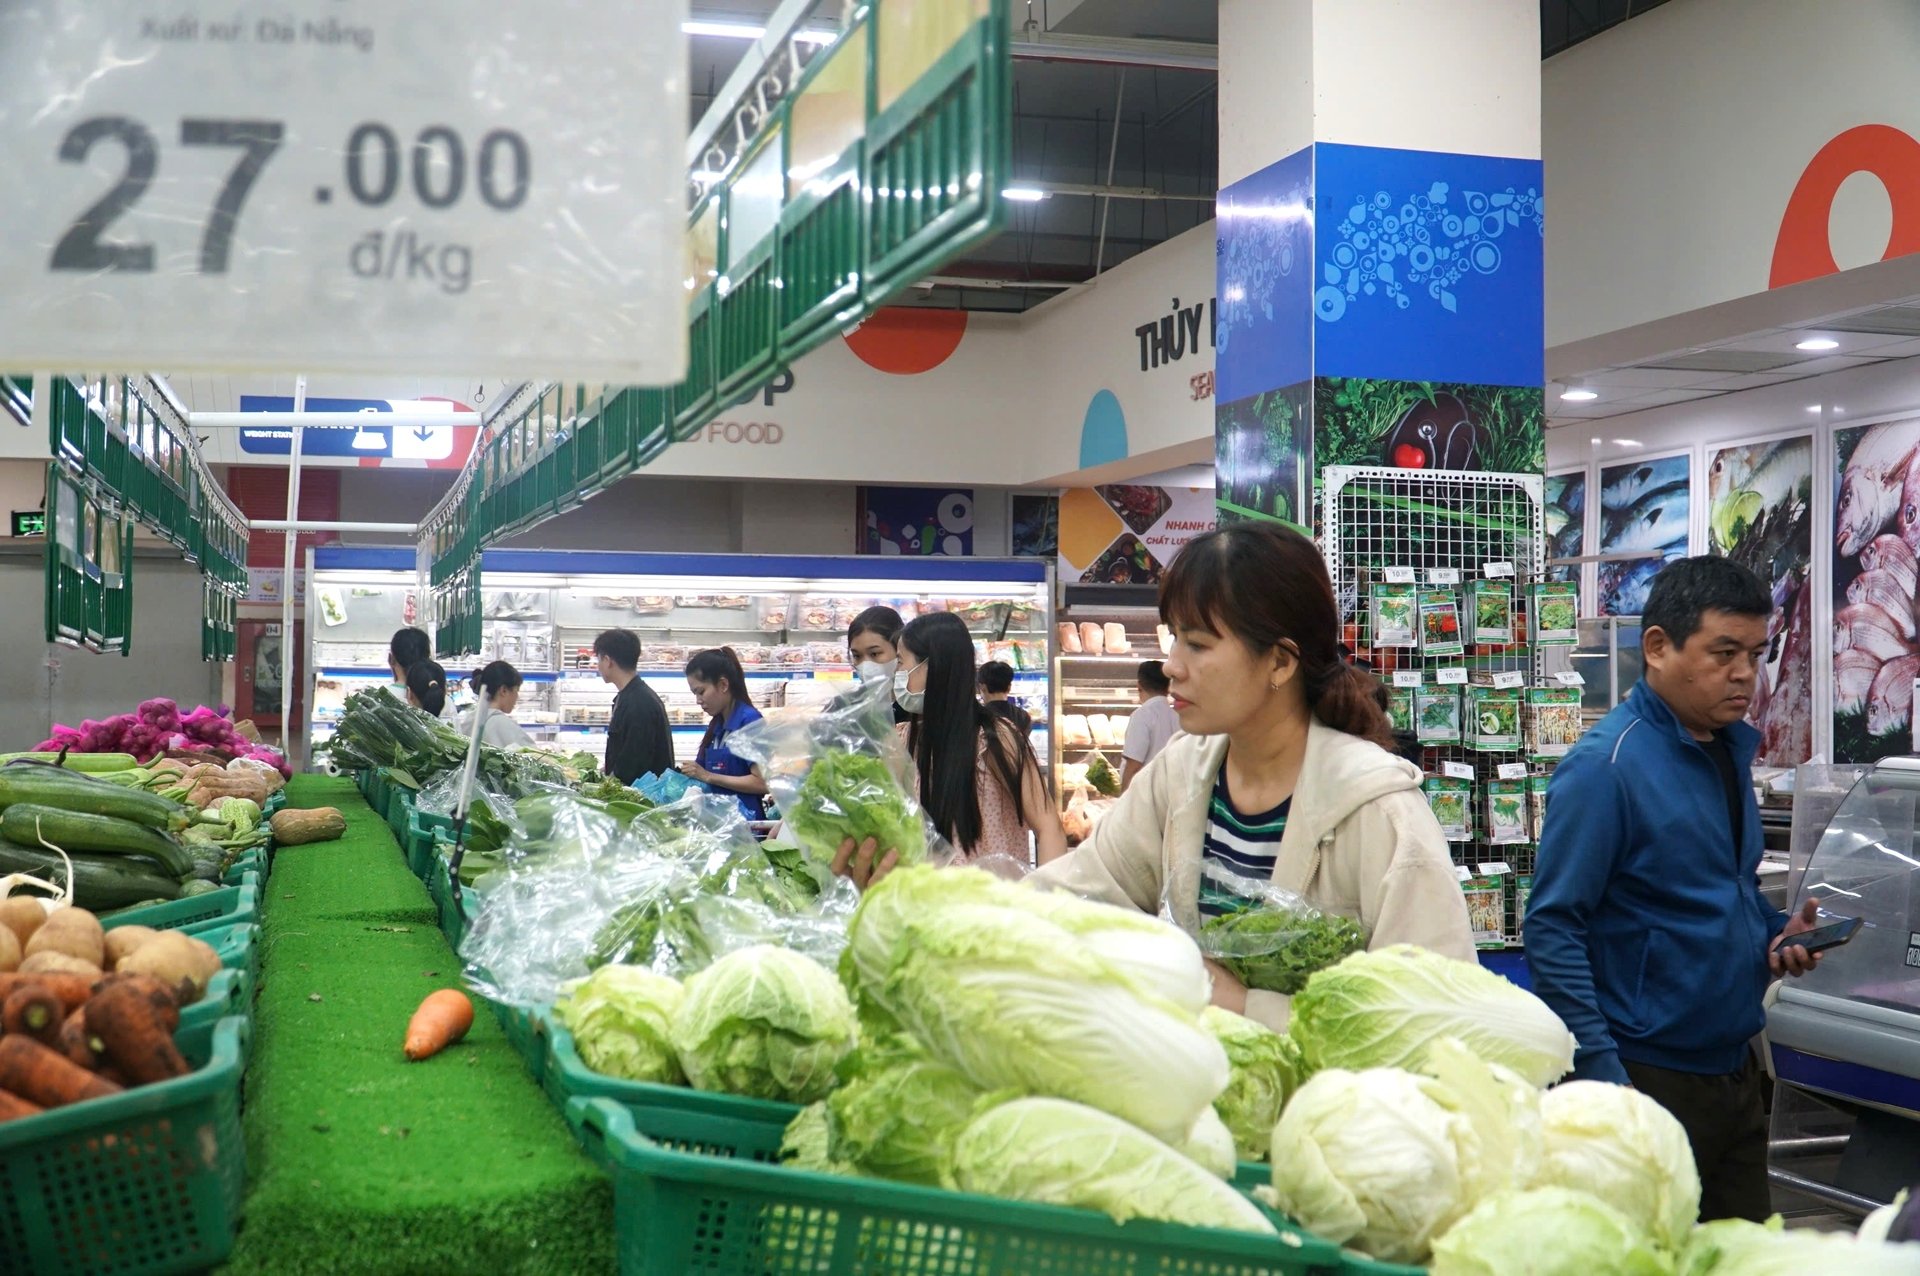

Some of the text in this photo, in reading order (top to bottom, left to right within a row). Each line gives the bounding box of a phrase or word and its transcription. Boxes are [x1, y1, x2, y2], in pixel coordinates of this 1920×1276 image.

[349, 230, 474, 295] đ/kg
[1135, 297, 1204, 372] THỦY
[707, 421, 784, 445] FOOD
[1165, 520, 1205, 531] NHANH
[1145, 534, 1170, 545] CHẤT
[266, 625, 278, 634] 04
